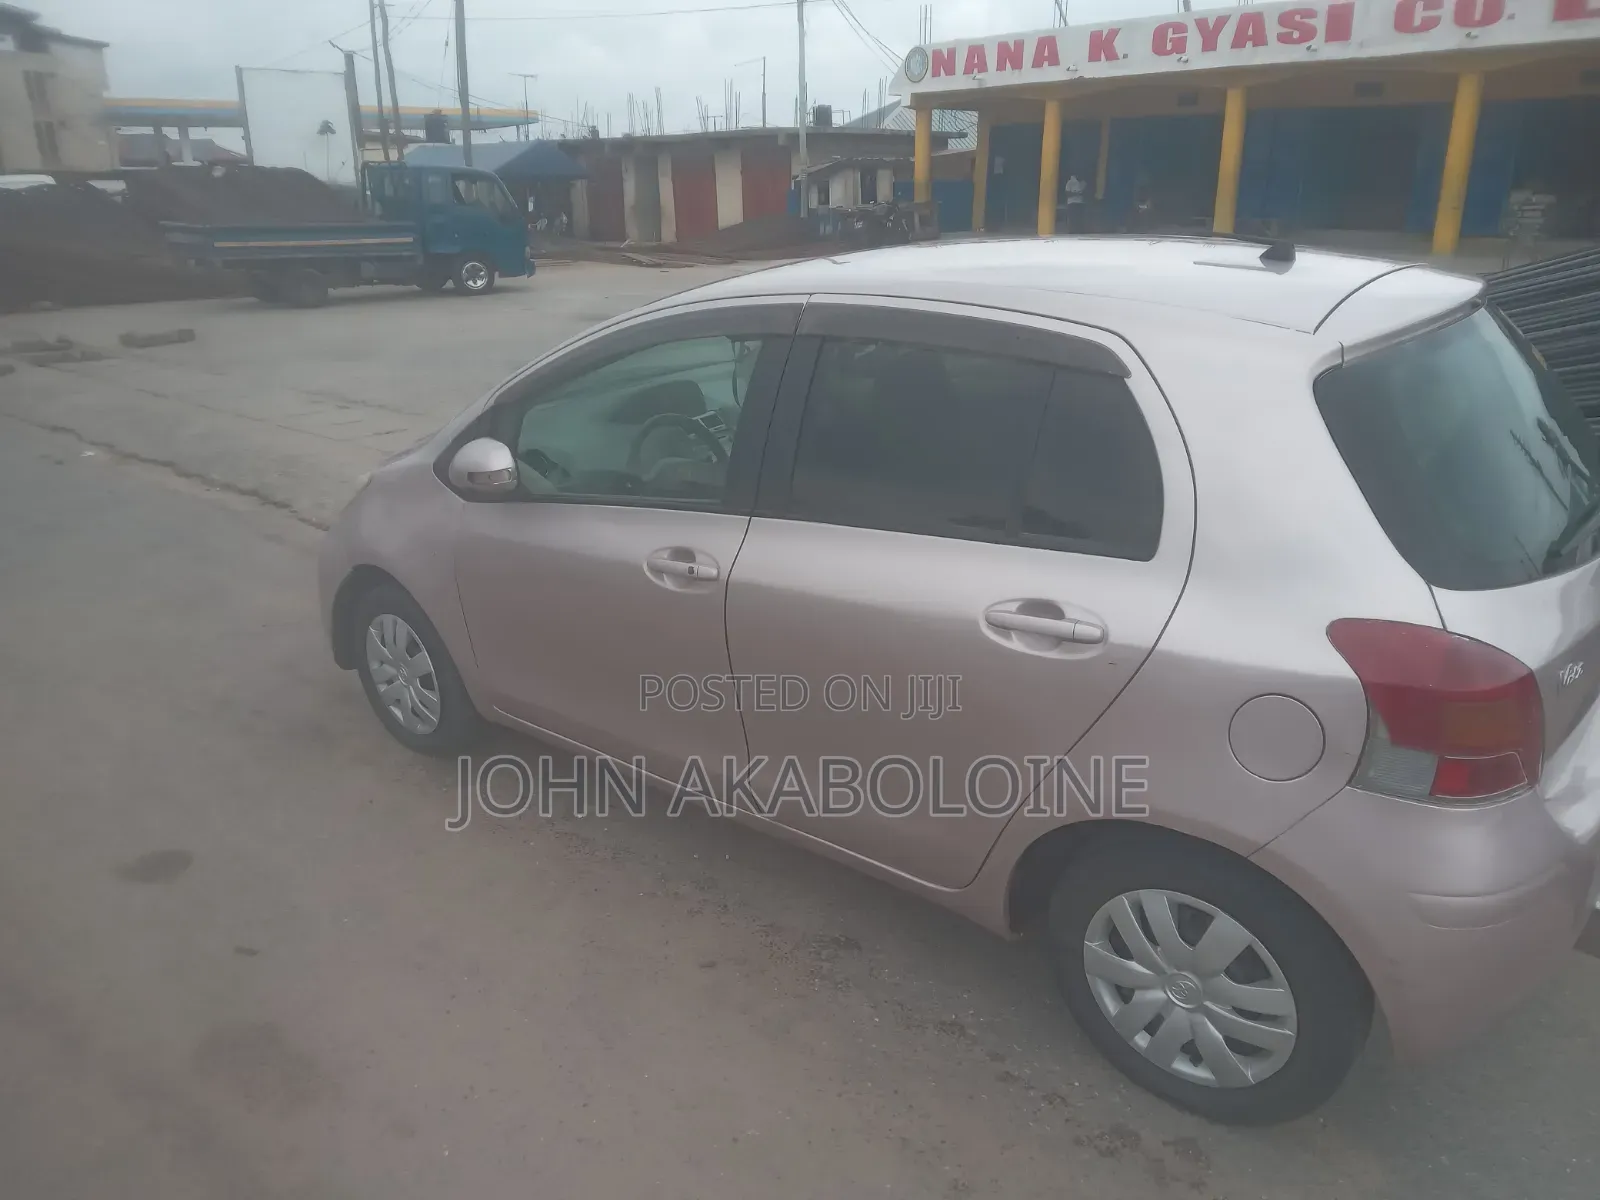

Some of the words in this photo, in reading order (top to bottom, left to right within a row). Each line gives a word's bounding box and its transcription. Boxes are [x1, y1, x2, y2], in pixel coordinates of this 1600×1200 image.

[931, 36, 1061, 78] NANA
[1088, 28, 1129, 63] K.
[1152, 2, 1355, 57] GYASI
[1394, 0, 1516, 34] CO.
